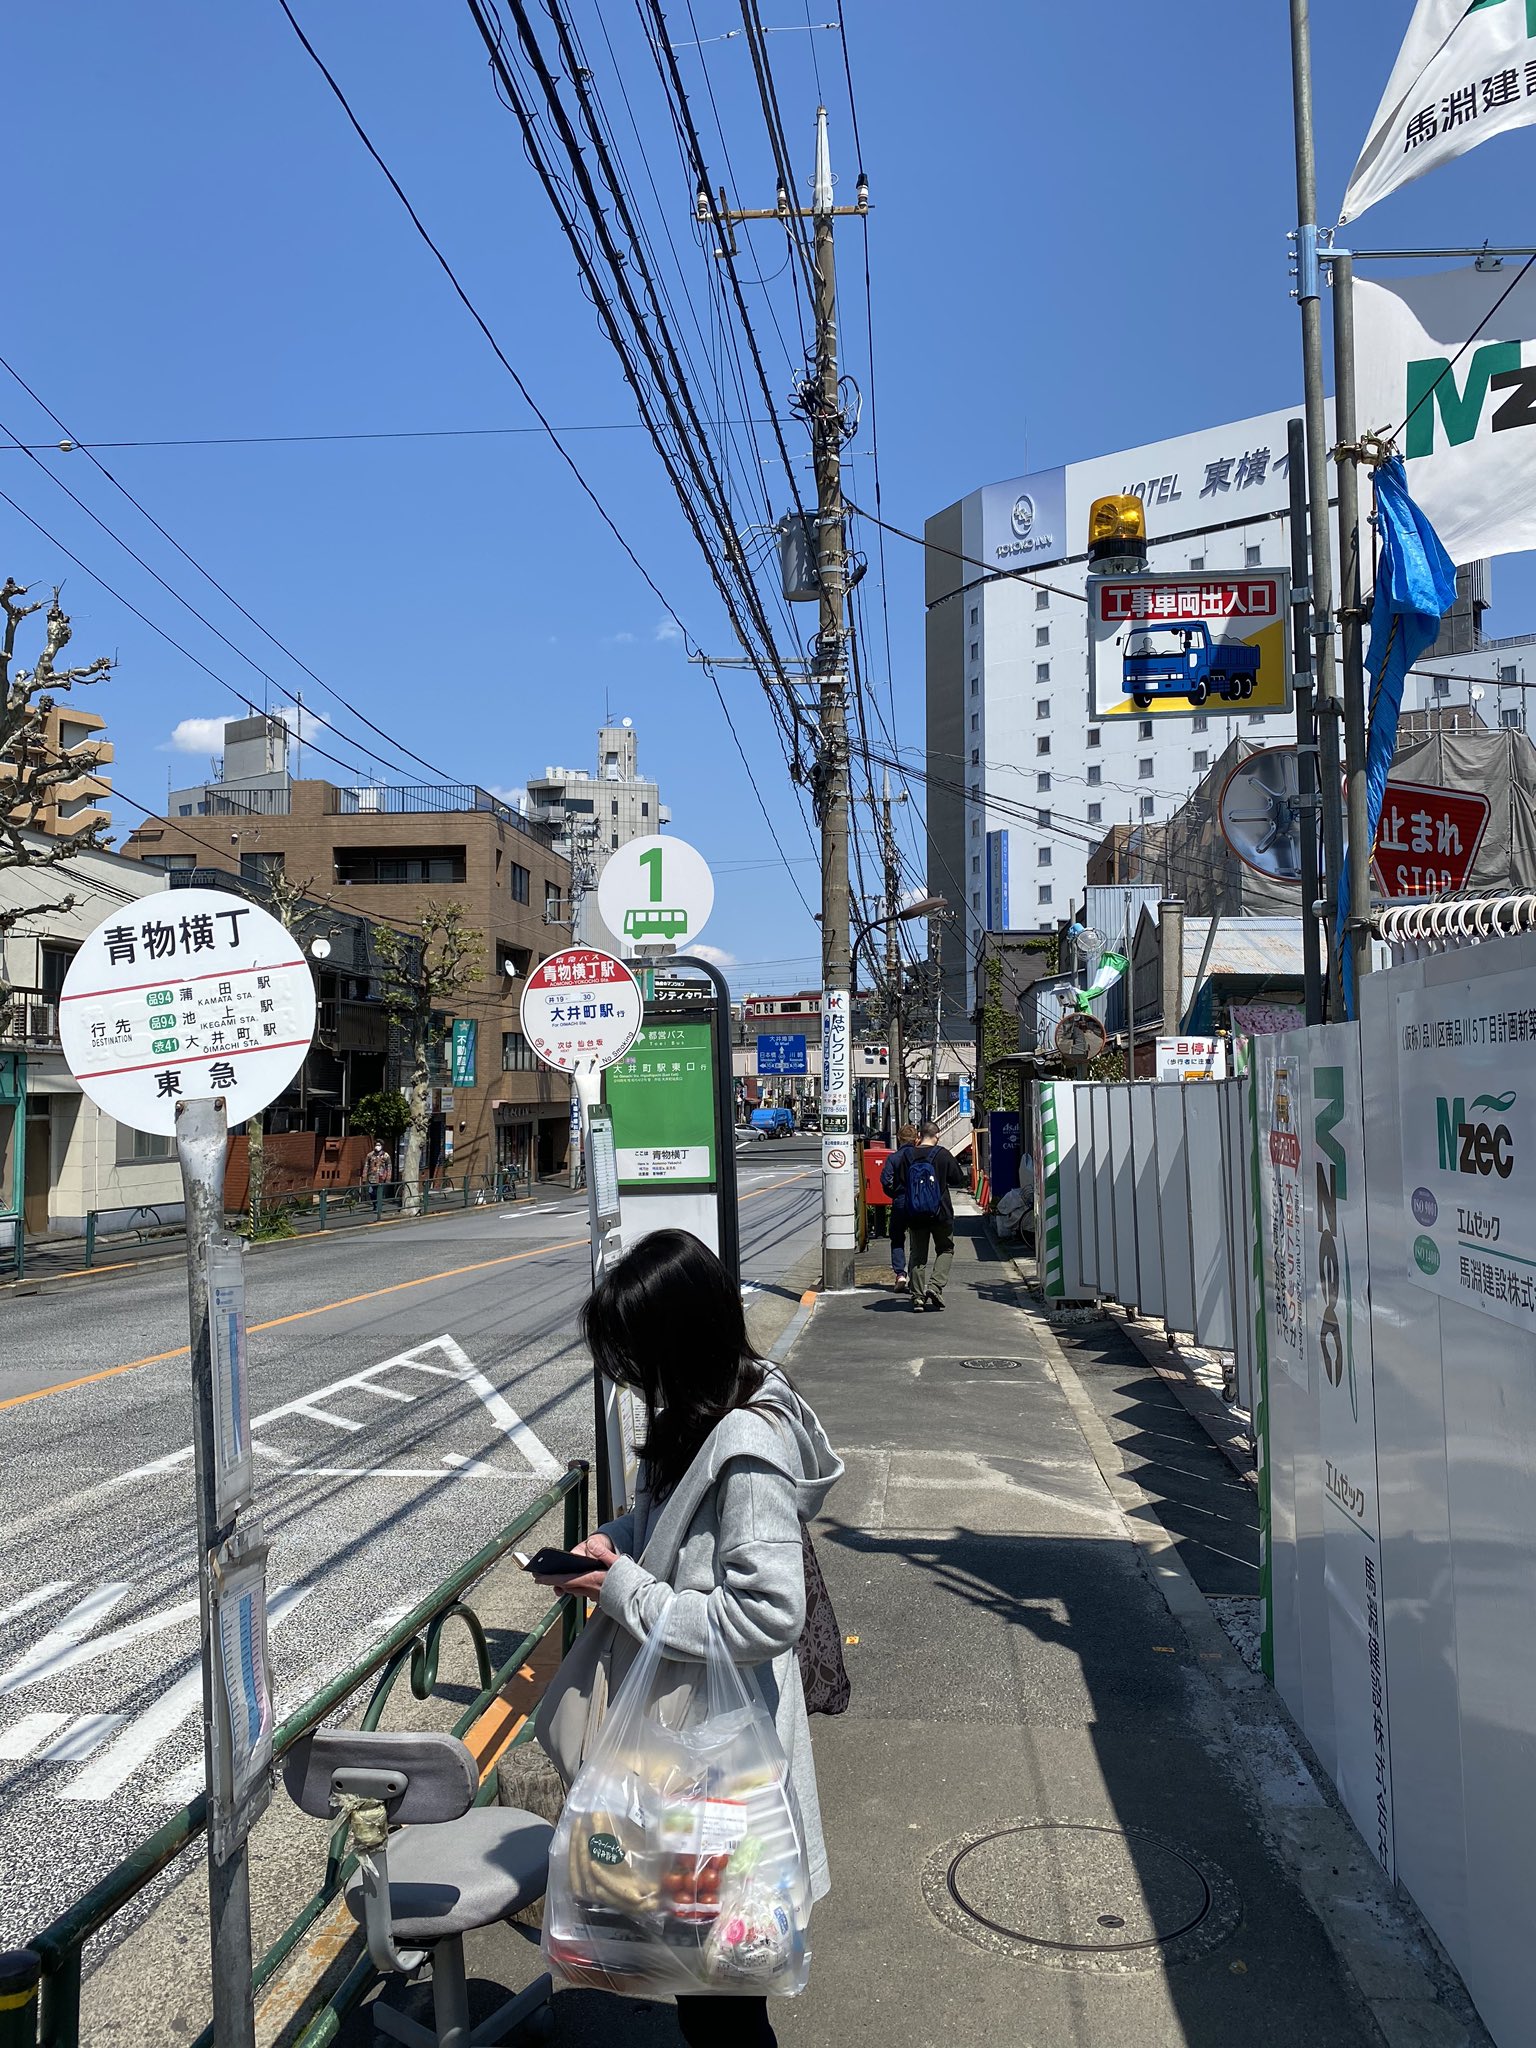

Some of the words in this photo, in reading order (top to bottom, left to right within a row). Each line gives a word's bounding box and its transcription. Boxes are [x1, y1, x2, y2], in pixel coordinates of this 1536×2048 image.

[1199, 446, 1336, 499] 東横イ
[1108, 585, 1270, 618] 工事車両出入口
[1380, 805, 1463, 857] 止まれ
[640, 847, 662, 902] 1
[1396, 864, 1452, 897] STOP
[104, 908, 251, 966] 青物横丁
[543, 960, 616, 982] 青物横丁駅
[148, 991, 172, 1005] 品94
[179, 975, 271, 1002] 蒲田駅
[198, 995, 233, 1006] KAMATA
[236, 991, 255, 1000] STA.
[90, 1018, 132, 1038] 行先
[151, 1015, 175, 1029] 品94
[182, 998, 274, 1025] 池上駅
[200, 1019, 236, 1030] IKEGAMI
[239, 1015, 259, 1024] STA.
[91, 1034, 133, 1048] DESTINATION
[154, 1038, 178, 1053] 渋41
[185, 1022, 277, 1049] 大井町駅
[243, 1039, 262, 1047] STA.
[558, 1041, 572, 1049] 次は
[577, 1039, 604, 1048] 仙台坂
[601, 1055, 612, 1064] No
[611, 1031, 634, 1057] Smoking
[648, 1030, 685, 1040] 都営バス
[1161, 1042, 1219, 1056] 一旦停止
[832, 1014, 845, 1090] はやしクリニック
[154, 1062, 238, 1098] 東急
[1436, 1096, 1515, 1179] Mzec
[652, 1149, 689, 1160] 青物横丁
[1413, 1199, 1424, 1213] ISO
[1313, 1066, 1347, 1389] Mzec
[1457, 1208, 1500, 1241] エムゼック
[1416, 1246, 1425, 1259] ISO
[1460, 1255, 1536, 1312] 馬淵建設株式
[1325, 1459, 1366, 1519] エムゼック
